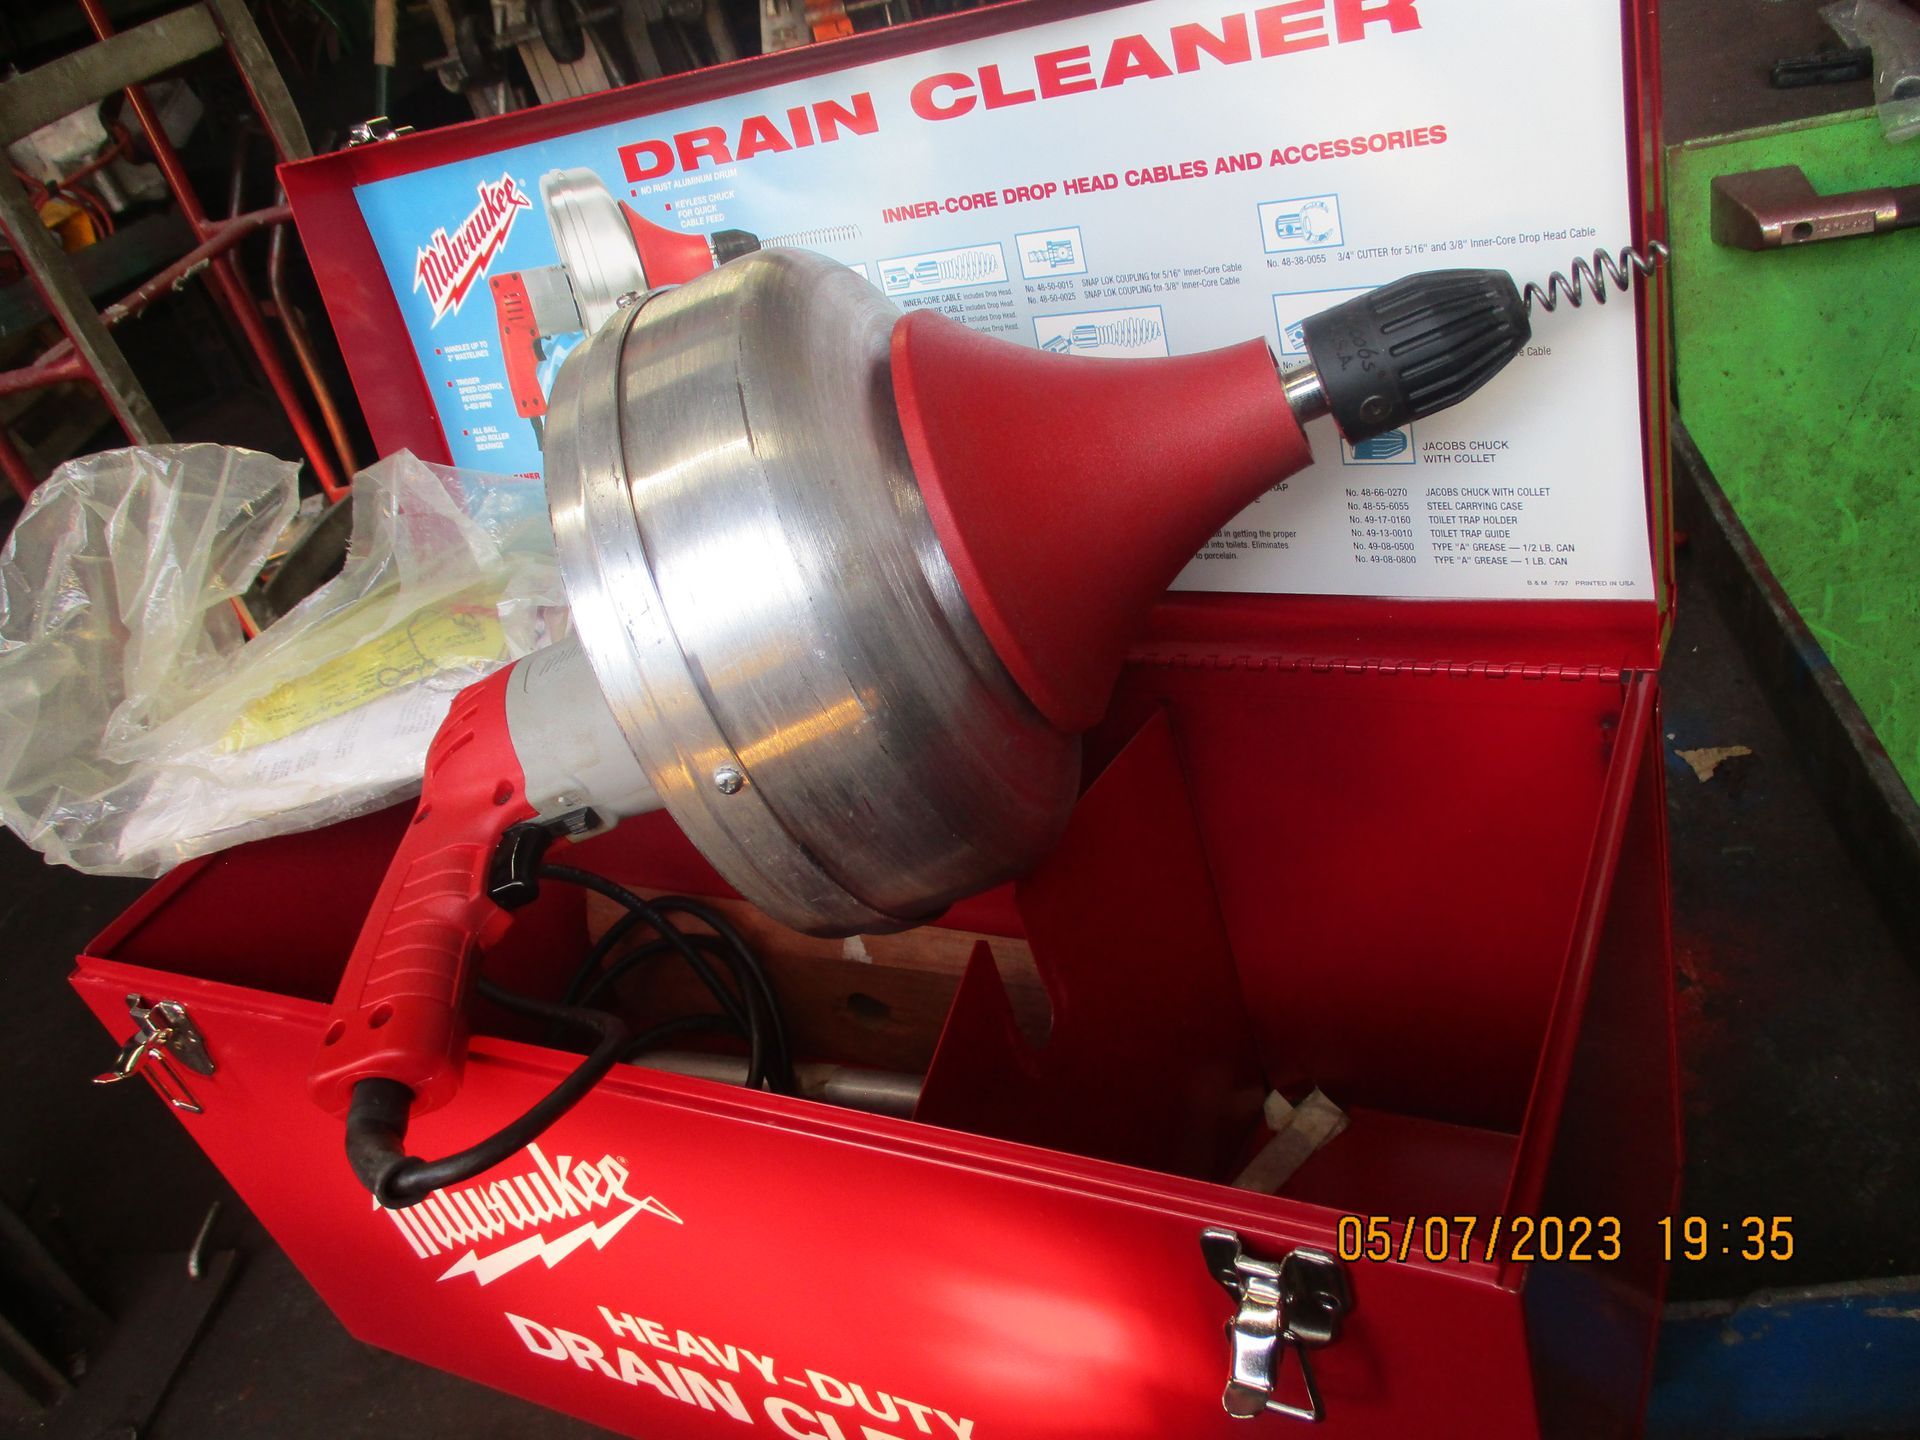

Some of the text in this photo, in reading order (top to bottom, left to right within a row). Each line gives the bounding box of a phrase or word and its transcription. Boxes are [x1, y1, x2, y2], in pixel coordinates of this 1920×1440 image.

[618, 0, 1423, 184] DRAIN CLEANER
[640, 167, 738, 196] NO RUST ALUMINUM DRUM
[882, 124, 1448, 224] INNER-CORE DROP HEAD CABLES AND ACCESSORIES
[675, 190, 736, 209] KEYLESS CHUCK
[678, 204, 718, 219] FOR QUICK
[680, 212, 726, 229] CABLE FEED
[414, 176, 529, 306] Milwaukee
[1266, 259, 1279, 268] No.
[1281, 254, 1327, 267] 48-38-0055
[1357, 247, 1389, 260] CUTTER
[1391, 246, 1402, 256] for
[1404, 243, 1428, 255] 5/16"
[1431, 242, 1447, 252] and
[1449, 239, 1468, 251] 3/8"
[1470, 236, 1517, 248] Inner-Core
[1519, 233, 1540, 245] Drop
[1543, 230, 1567, 241] Head
[1569, 227, 1596, 238] Cable
[1081, 278, 1100, 288] SNAP
[1101, 276, 1115, 286] LOK
[1115, 272, 1150, 285] COUPLING
[1150, 271, 1161, 280] for
[1162, 268, 1181, 280] 5/16"
[1183, 265, 1221, 277] Inner-Core
[1221, 263, 1243, 273] Cable
[1083, 289, 1102, 299] SNAP
[1103, 287, 1117, 297] LOK
[1117, 284, 1152, 296] COUPLING
[1153, 283, 1163, 292] for
[1164, 281, 1180, 291] 3/8"
[1181, 278, 1220, 290] Inner-Core
[1219, 276, 1241, 286] Cable
[903, 296, 941, 308] INNER-CORE
[941, 292, 963, 304] CABLE
[963, 290, 985, 300] includes
[985, 289, 998, 299] Drop
[943, 304, 964, 315] CABLE
[986, 301, 1000, 310] Drop
[1526, 346, 1552, 357] Cable
[1422, 440, 1510, 451] JACOBS CHUCK
[1423, 453, 1497, 464] WITH COLLET
[1345, 487, 1551, 497] No. 48-66-0270 JACOBS CHUCK WITH COLLET
[1347, 502, 1524, 511] No. 48-55-6055 STEEL CARRYING CASE
[1349, 515, 1518, 525] No. 49-17-0160 TOILET TRAP HOLDER
[1232, 530, 1258, 539] getting
[1258, 530, 1271, 538] the
[1273, 531, 1297, 540] proper
[1351, 529, 1511, 539] No. 49-13-0010 TOILET TRAP GUIDE
[1211, 541, 1225, 549] into
[1251, 541, 1289, 549] Eliminates
[1353, 542, 1575, 553] No. 49-08-0500 TYPE "A" GREASE 1/2 LB. CAN
[1355, 555, 1568, 566] No. 49-08-0800 TYPE "A" GREASE 1 LB. CAN
[505, 1312, 754, 1424] DRAIN
[597, 1305, 975, 1440] HEAVY-DUTY
